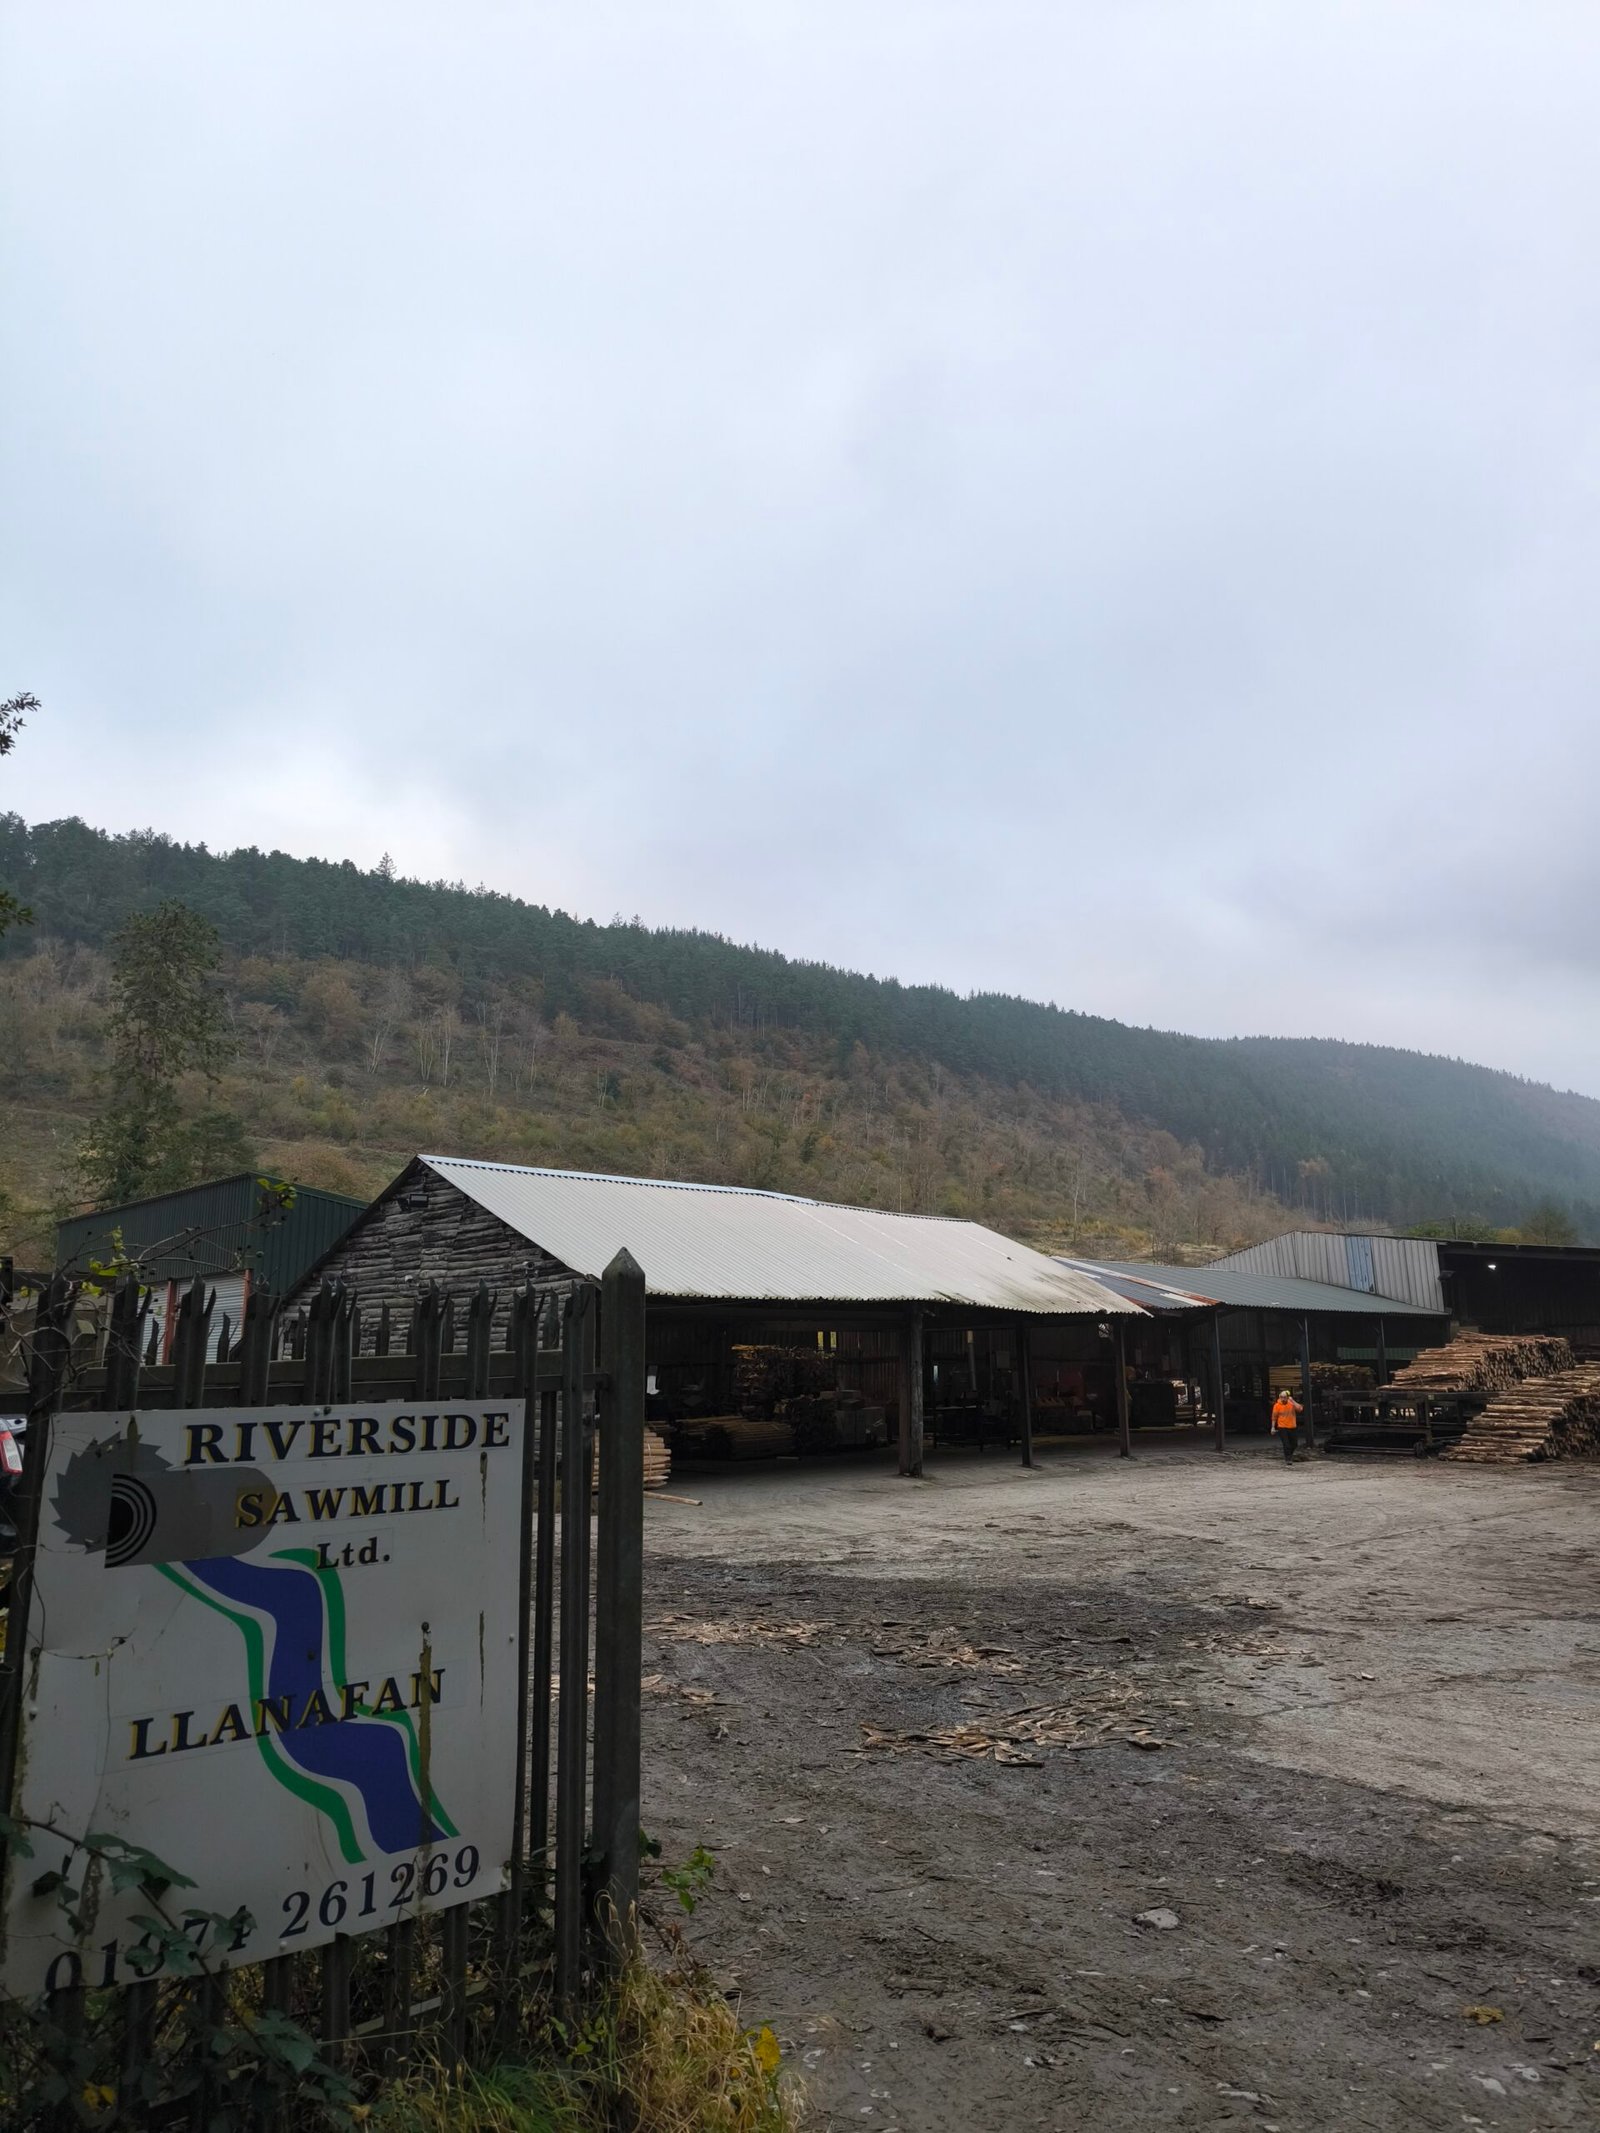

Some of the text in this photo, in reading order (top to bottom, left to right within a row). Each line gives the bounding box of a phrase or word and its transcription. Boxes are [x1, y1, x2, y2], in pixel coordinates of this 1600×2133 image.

[185, 1412, 511, 1465] RIVERSIDE
[236, 1479, 460, 1529] SAWMILL
[317, 1537, 390, 1570] Ltd.
[127, 1668, 445, 1760] LLANAFAN
[279, 1846, 481, 1938] 261269
